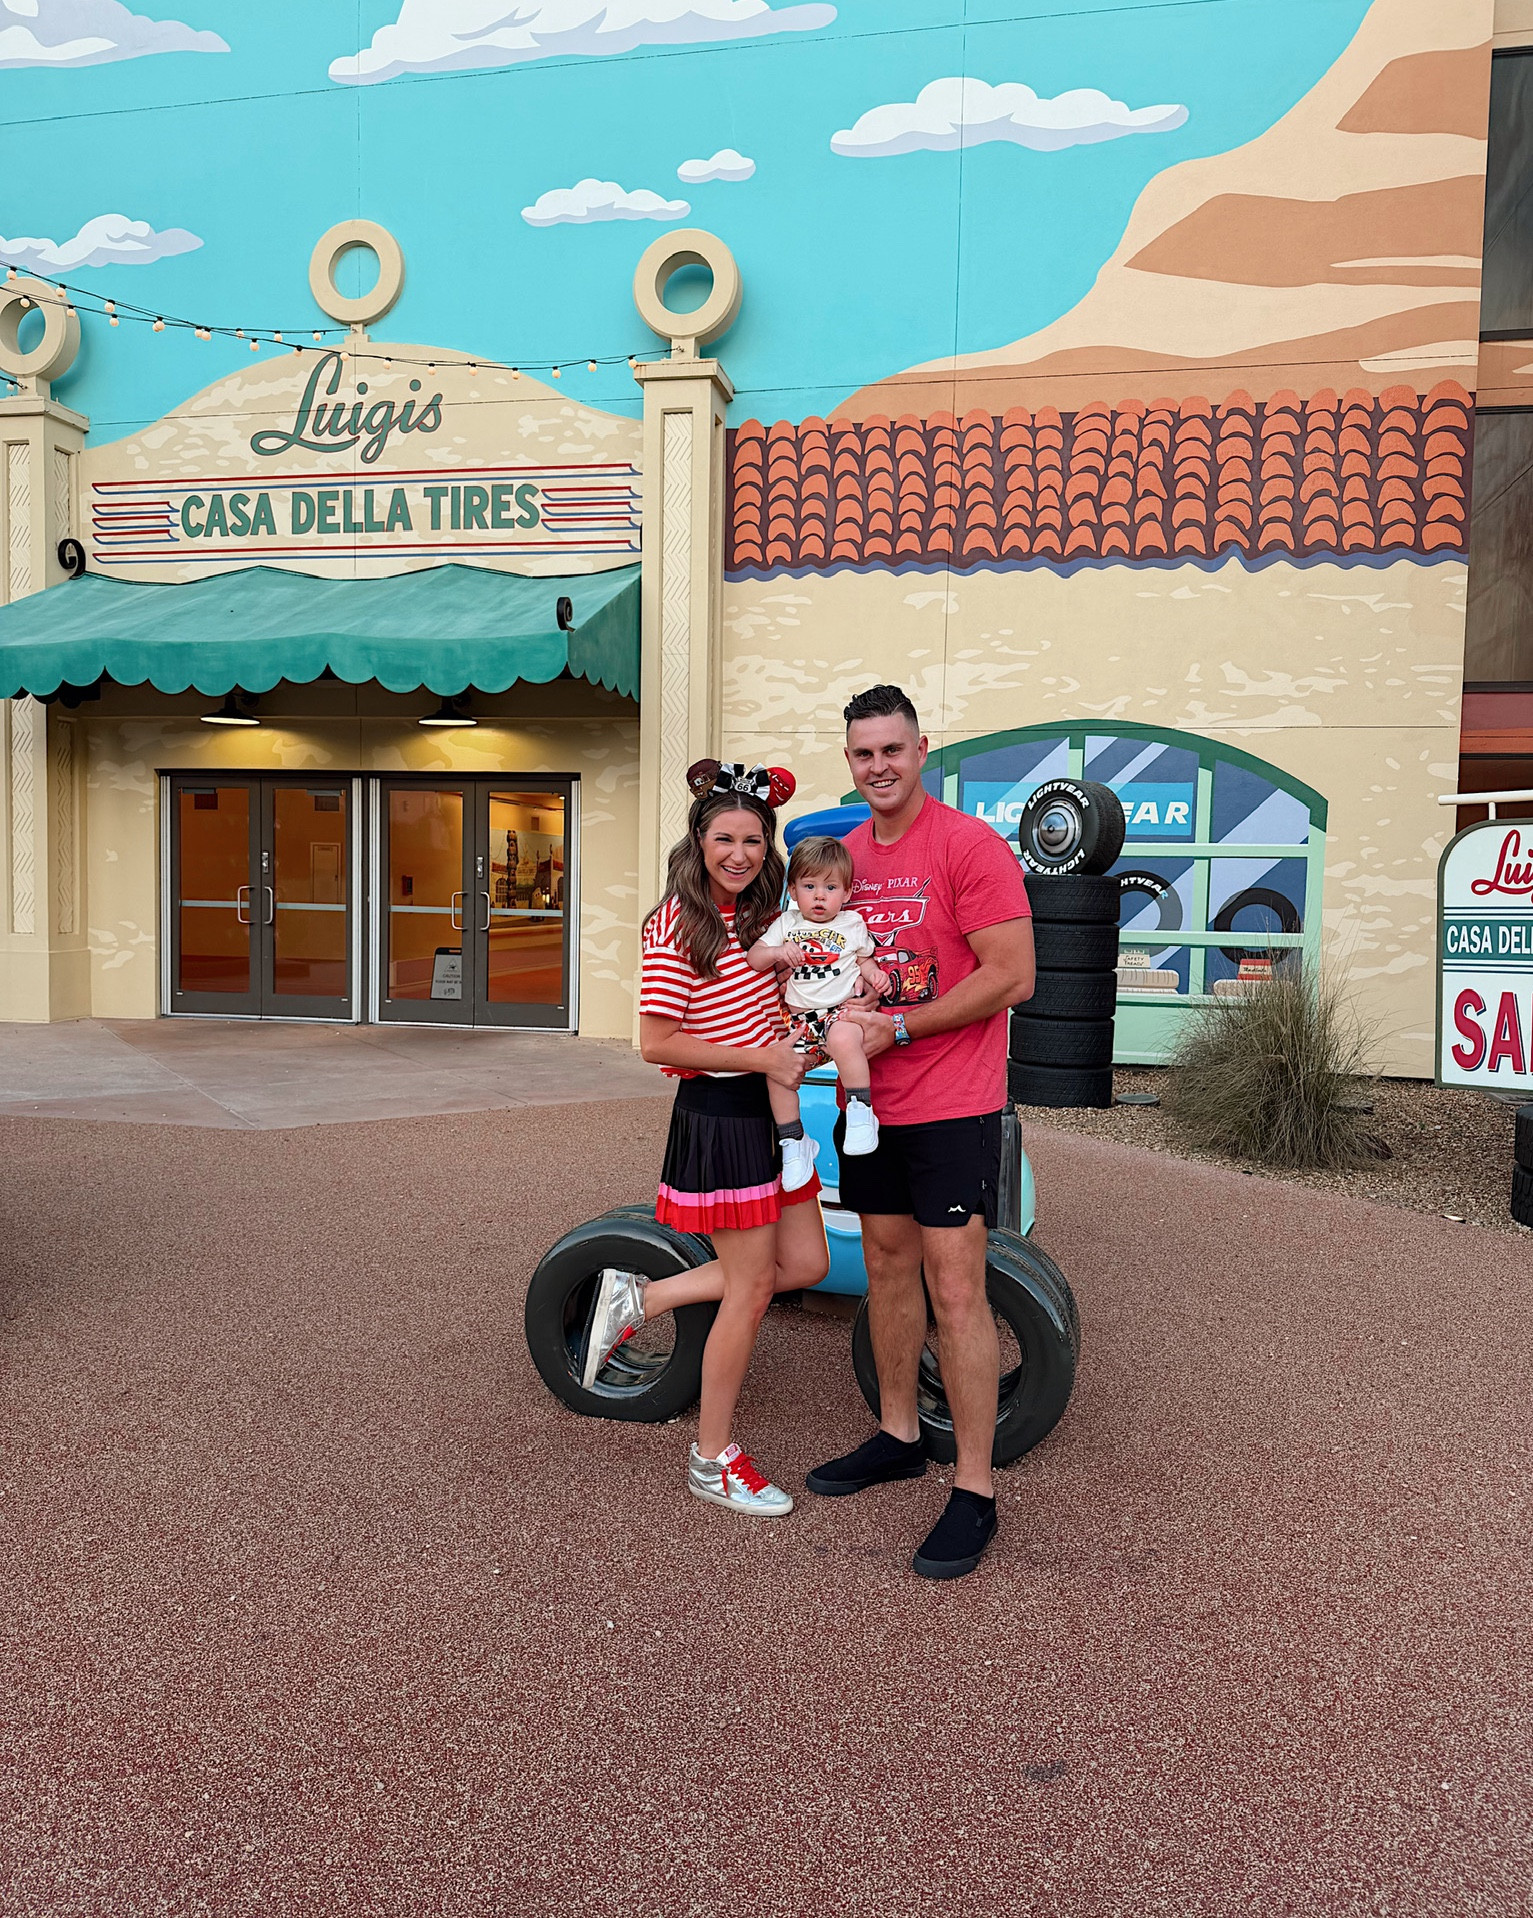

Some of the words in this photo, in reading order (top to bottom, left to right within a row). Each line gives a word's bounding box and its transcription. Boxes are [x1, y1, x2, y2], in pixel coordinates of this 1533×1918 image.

[250, 352, 443, 464] Luigis
[181, 492, 277, 538] CASA
[291, 487, 414, 535] DELLA
[423, 483, 541, 531] TIRES
[737, 783, 749, 791] 66
[1027, 782, 1090, 811] LIGHTYEAR
[1470, 829, 1533, 904] Lui
[887, 877, 918, 889] PIXAR
[1446, 925, 1493, 954] CASA
[1499, 926, 1533, 954] DEL
[908, 965, 921, 985] 95
[1451, 988, 1533, 1076] SA
